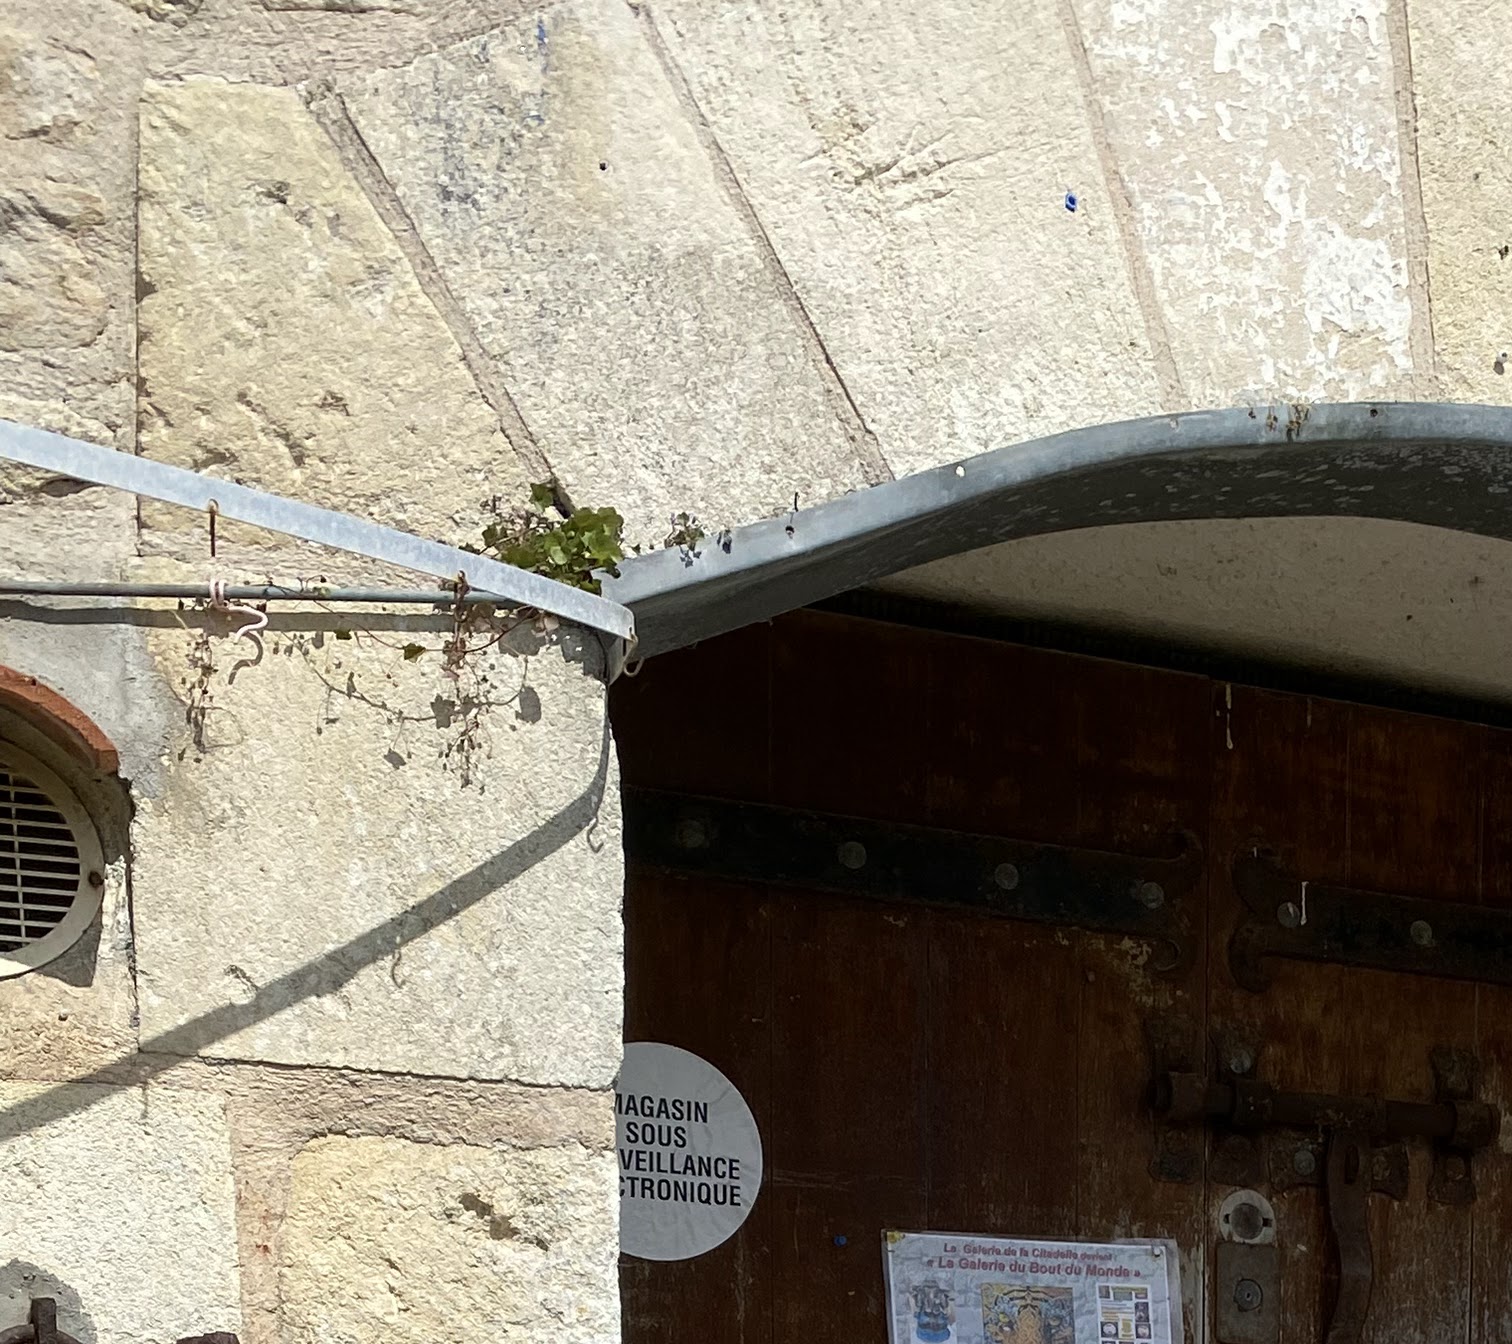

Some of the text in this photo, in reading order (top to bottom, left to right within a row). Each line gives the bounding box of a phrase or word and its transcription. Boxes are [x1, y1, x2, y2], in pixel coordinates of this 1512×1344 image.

[626, 1122, 687, 1148] SOUS
[620, 1149, 741, 1180] VEILLANCE
[944, 1243, 957, 1253] La
[963, 1244, 1001, 1256] Galerie
[1004, 1246, 1016, 1256] de
[1019, 1247, 1028, 1257] la
[1032, 1248, 1078, 1260] Citadelle
[938, 1256, 954, 1269] La
[959, 1258, 1005, 1271] Galerie
[1009, 1260, 1025, 1273] du
[1030, 1262, 1061, 1275] Bout
[1065, 1264, 1081, 1276] du
[1086, 1265, 1130, 1277] Monde
